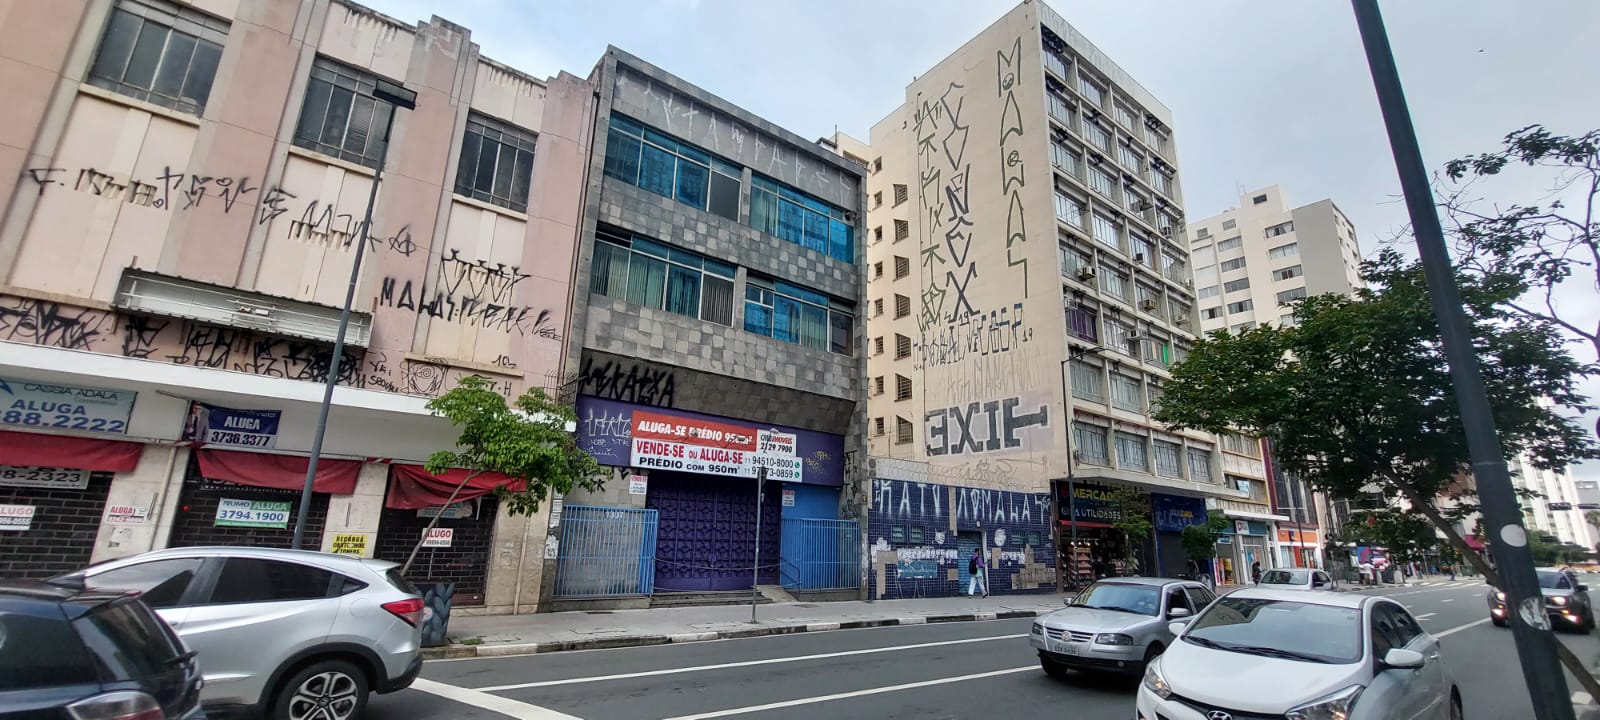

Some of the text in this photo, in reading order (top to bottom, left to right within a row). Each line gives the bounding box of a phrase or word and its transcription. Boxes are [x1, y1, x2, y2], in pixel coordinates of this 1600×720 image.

[11, 399, 86, 415] ALUGA
[0, 410, 125, 433] 88.2222
[223, 416, 261, 430] ALUGA
[637, 420, 686, 436] ALUGA-SE
[211, 431, 271, 447] 3736.3377
[636, 439, 685, 458] VENDE-SE
[689, 450, 698, 460] OU
[700, 447, 744, 465] ALUGA-SE
[752, 455, 794, 469] 94510-8000
[777, 445, 793, 453] 7900
[639, 455, 683, 469] PRÉDIO
[686, 463, 705, 472] COM
[751, 466, 794, 479] 9773-0859
[0, 469, 81, 483] 8-2323
[1073, 487, 1115, 501] MERCAD
[0, 507, 33, 516] LUGO
[110, 506, 133, 514] ALUGA
[252, 502, 287, 511] ALUGA
[220, 510, 285, 522] 3794.1900
[1081, 508, 1122, 520] UTILIDADES
[427, 530, 451, 538] LUGO
